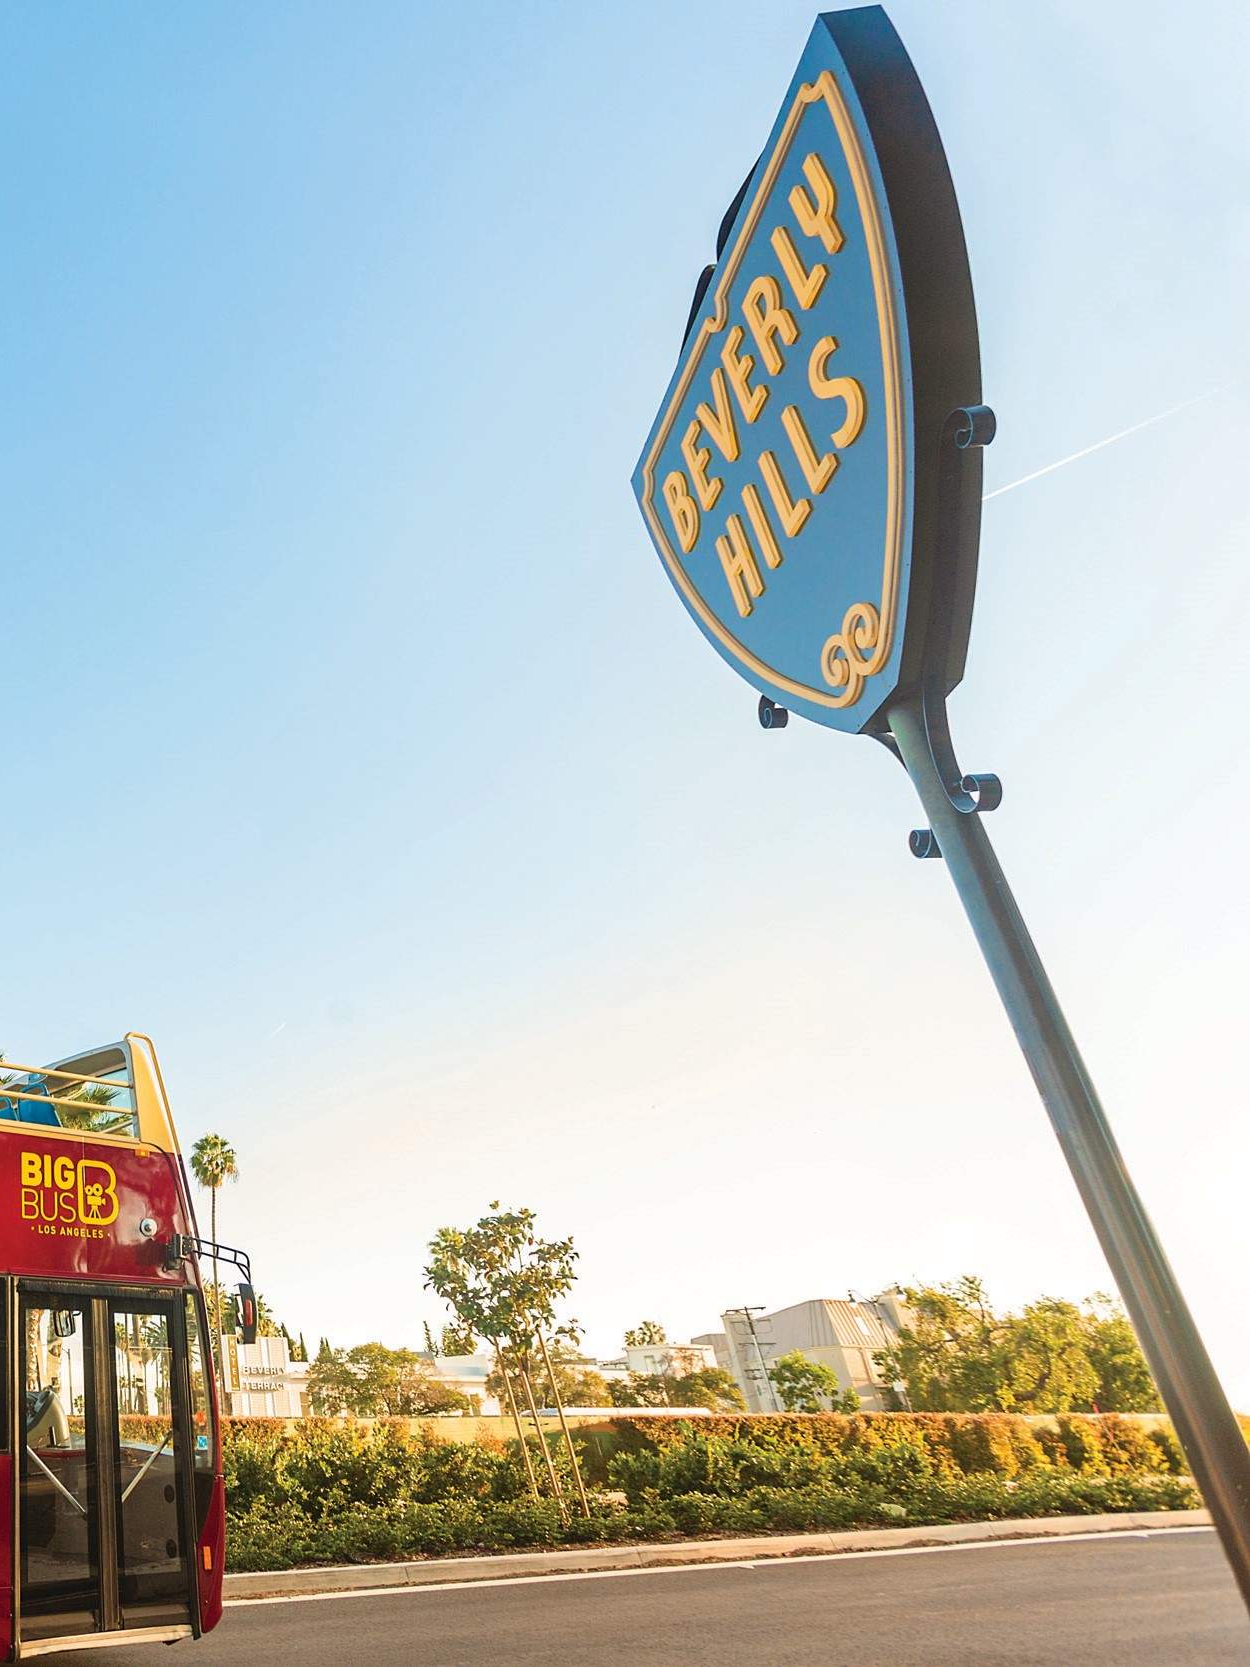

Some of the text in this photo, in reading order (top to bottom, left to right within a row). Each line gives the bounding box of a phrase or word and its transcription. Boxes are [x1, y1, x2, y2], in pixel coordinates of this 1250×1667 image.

[662, 152, 844, 555] BEVERLY
[715, 336, 868, 618] HILLS
[21, 1152, 76, 1190] BIG
[21, 1188, 77, 1223] BUS
[38, 1225, 104, 1239] LOS ANGELES
[229, 1338, 238, 1385] HOTEL
